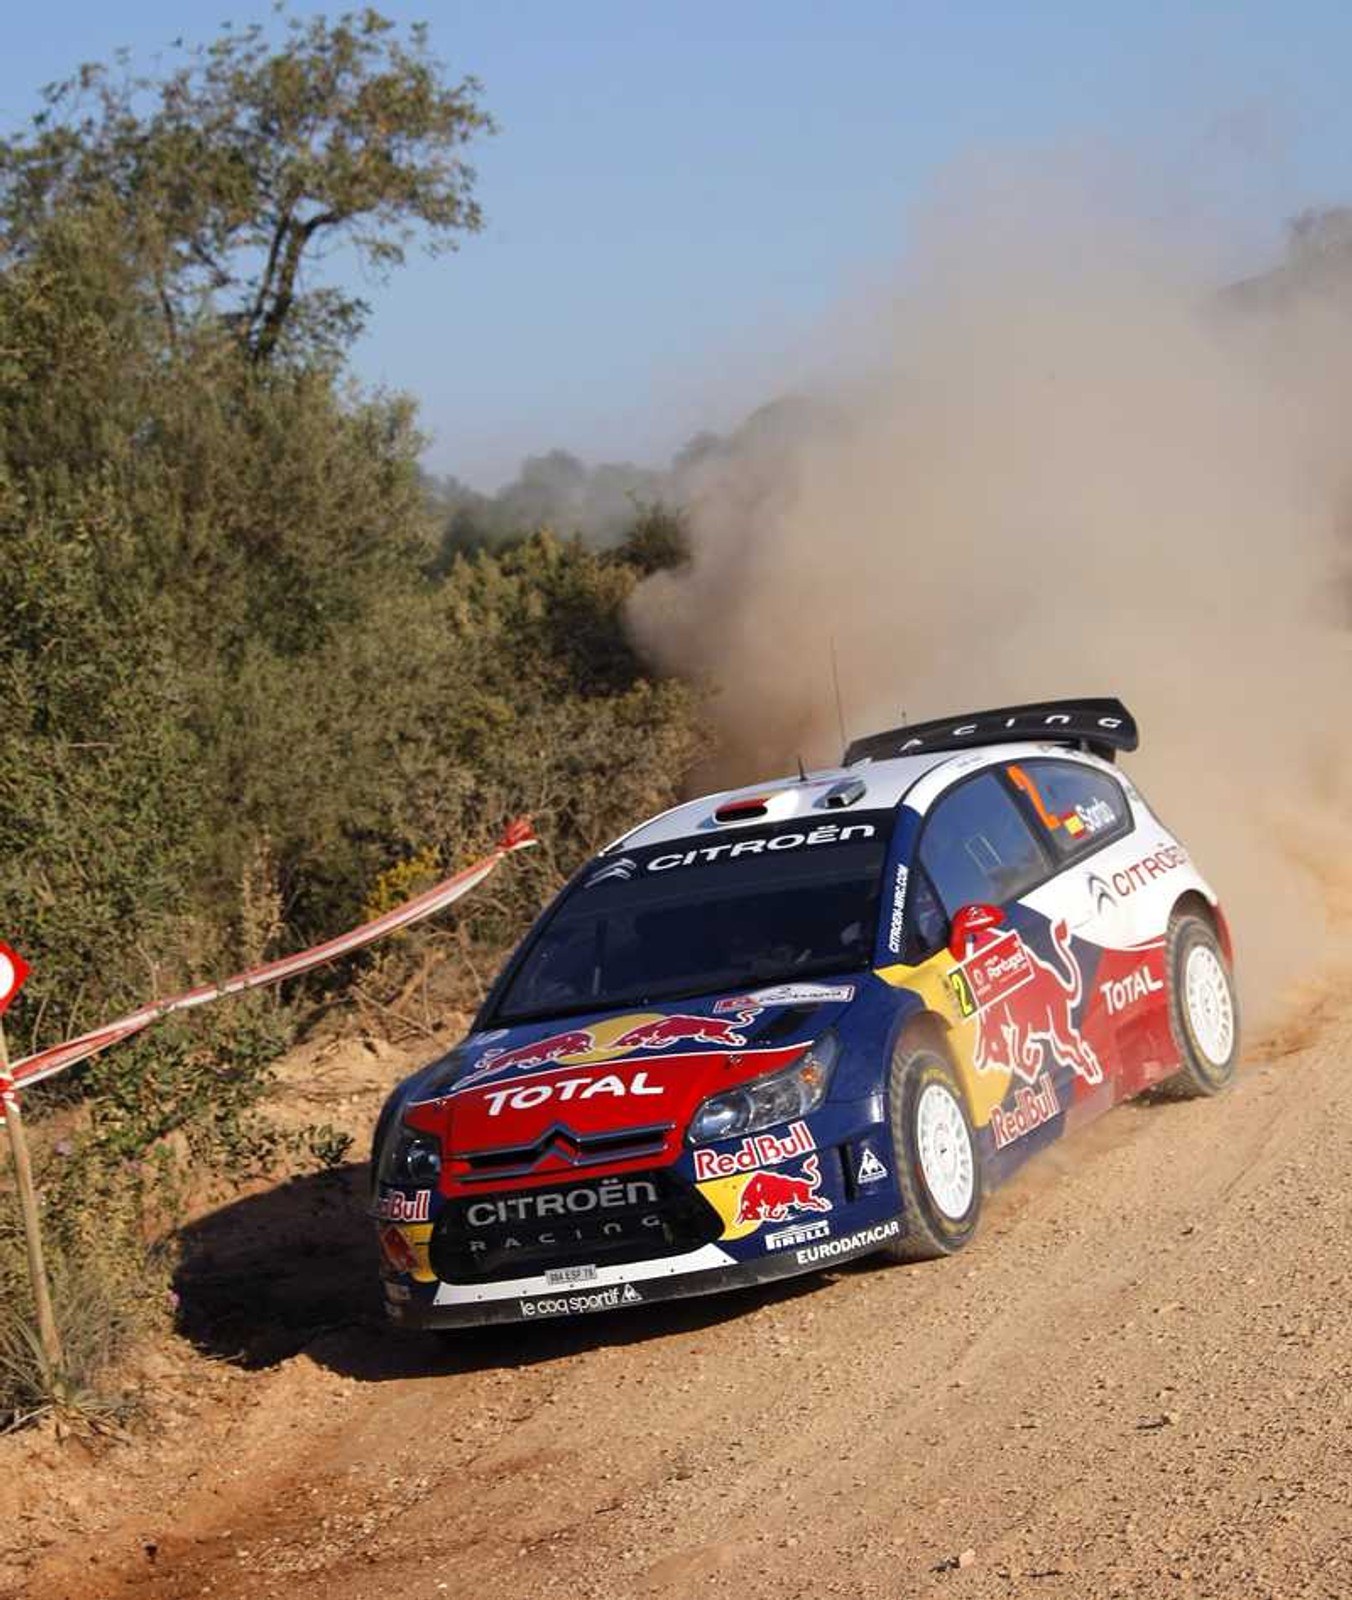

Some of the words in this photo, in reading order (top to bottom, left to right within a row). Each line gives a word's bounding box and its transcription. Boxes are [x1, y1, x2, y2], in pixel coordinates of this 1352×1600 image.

[1007, 765, 1061, 831] 2
[951, 973, 974, 1015] 2
[1099, 964, 1164, 1016] TOTAL
[484, 1072, 664, 1117] TOTAL
[989, 1090, 1029, 1150] Red
[1020, 1071, 1060, 1127] Bull
[694, 1137, 759, 1180] Red
[756, 1120, 817, 1165] Bull
[390, 1190, 430, 1222] Bull
[765, 1220, 830, 1250] PIRELLI
[796, 1220, 900, 1264] EURODATACAR
[520, 1300, 536, 1317] le
[537, 1297, 570, 1315] coq
[568, 1286, 620, 1314] sportif
